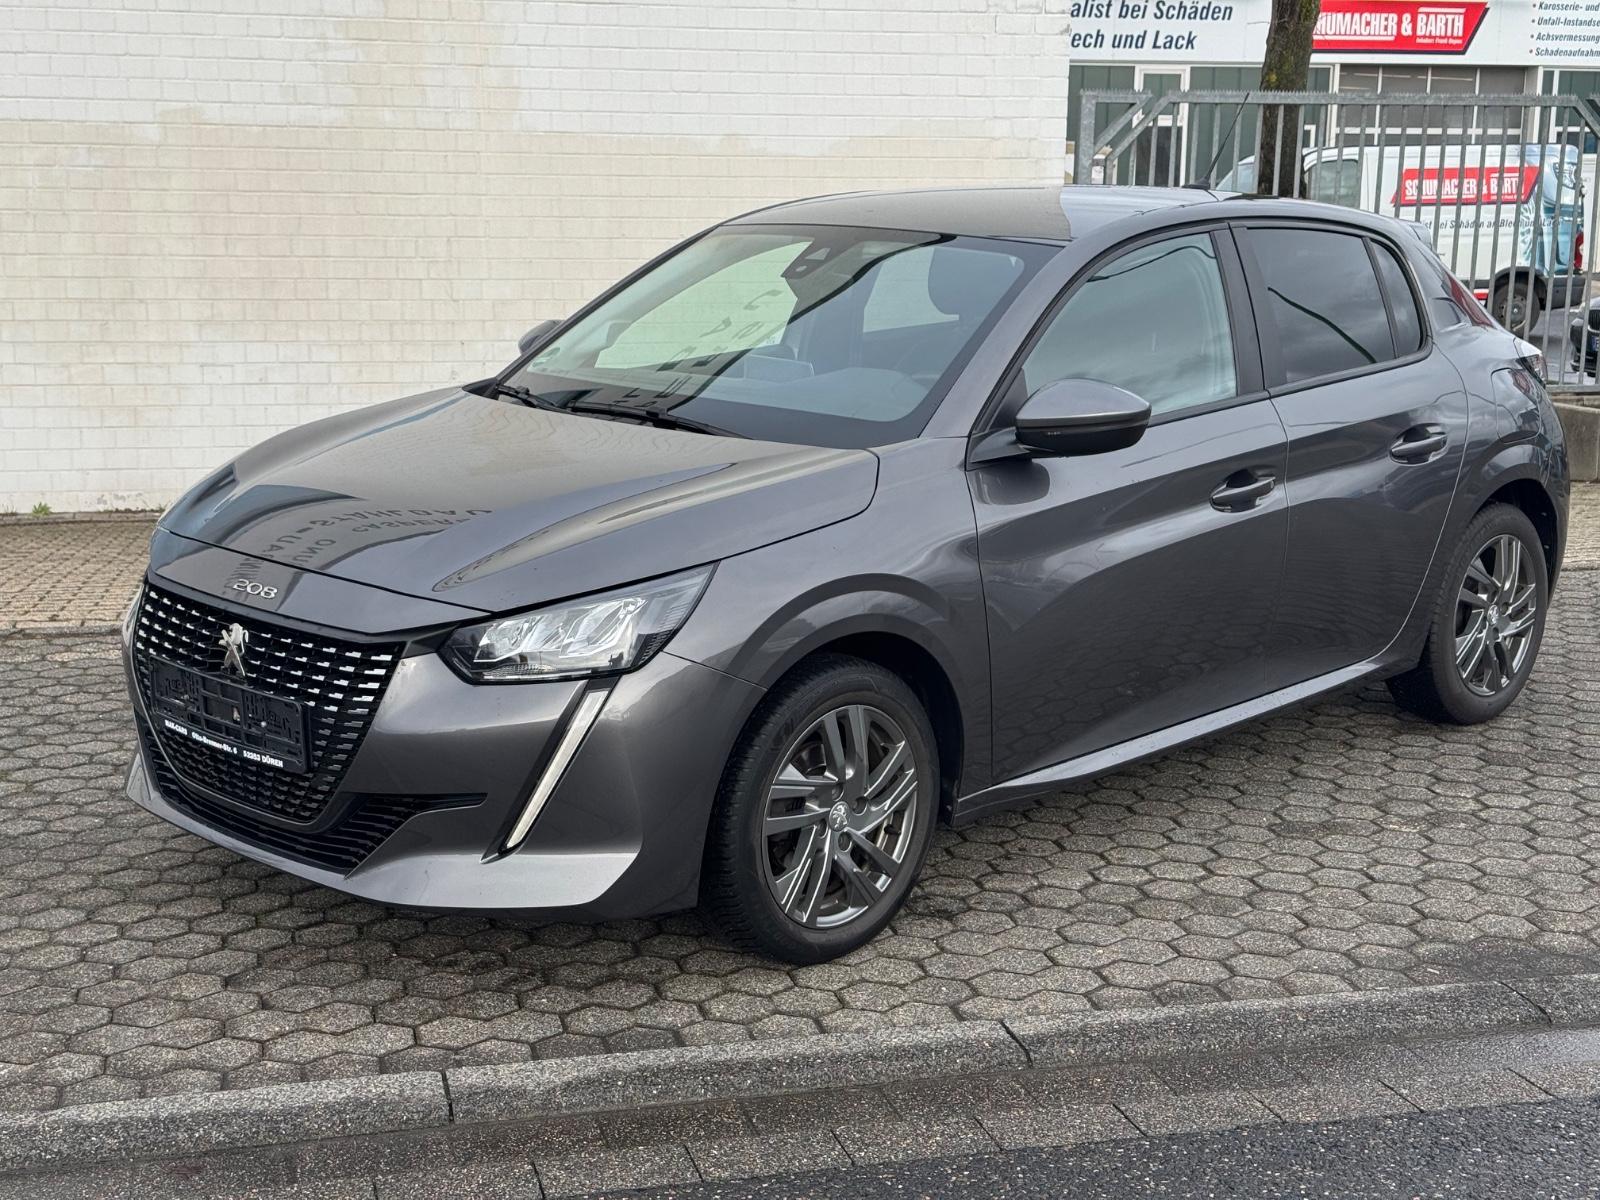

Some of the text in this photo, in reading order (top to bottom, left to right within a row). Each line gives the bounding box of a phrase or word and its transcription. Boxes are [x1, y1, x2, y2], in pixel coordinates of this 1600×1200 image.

[1071, 0, 1233, 21] alist bei Schäden
[1538, 2, 1600, 11] Karosserie- und
[1401, 13, 1413, 36] &
[1416, 14, 1464, 37] BARTH
[1071, 29, 1197, 50] ech und Lack
[1536, 32, 1600, 44] Achsvermessung
[233, 578, 278, 599] 208
[261, 755, 284, 768] DÜREN
